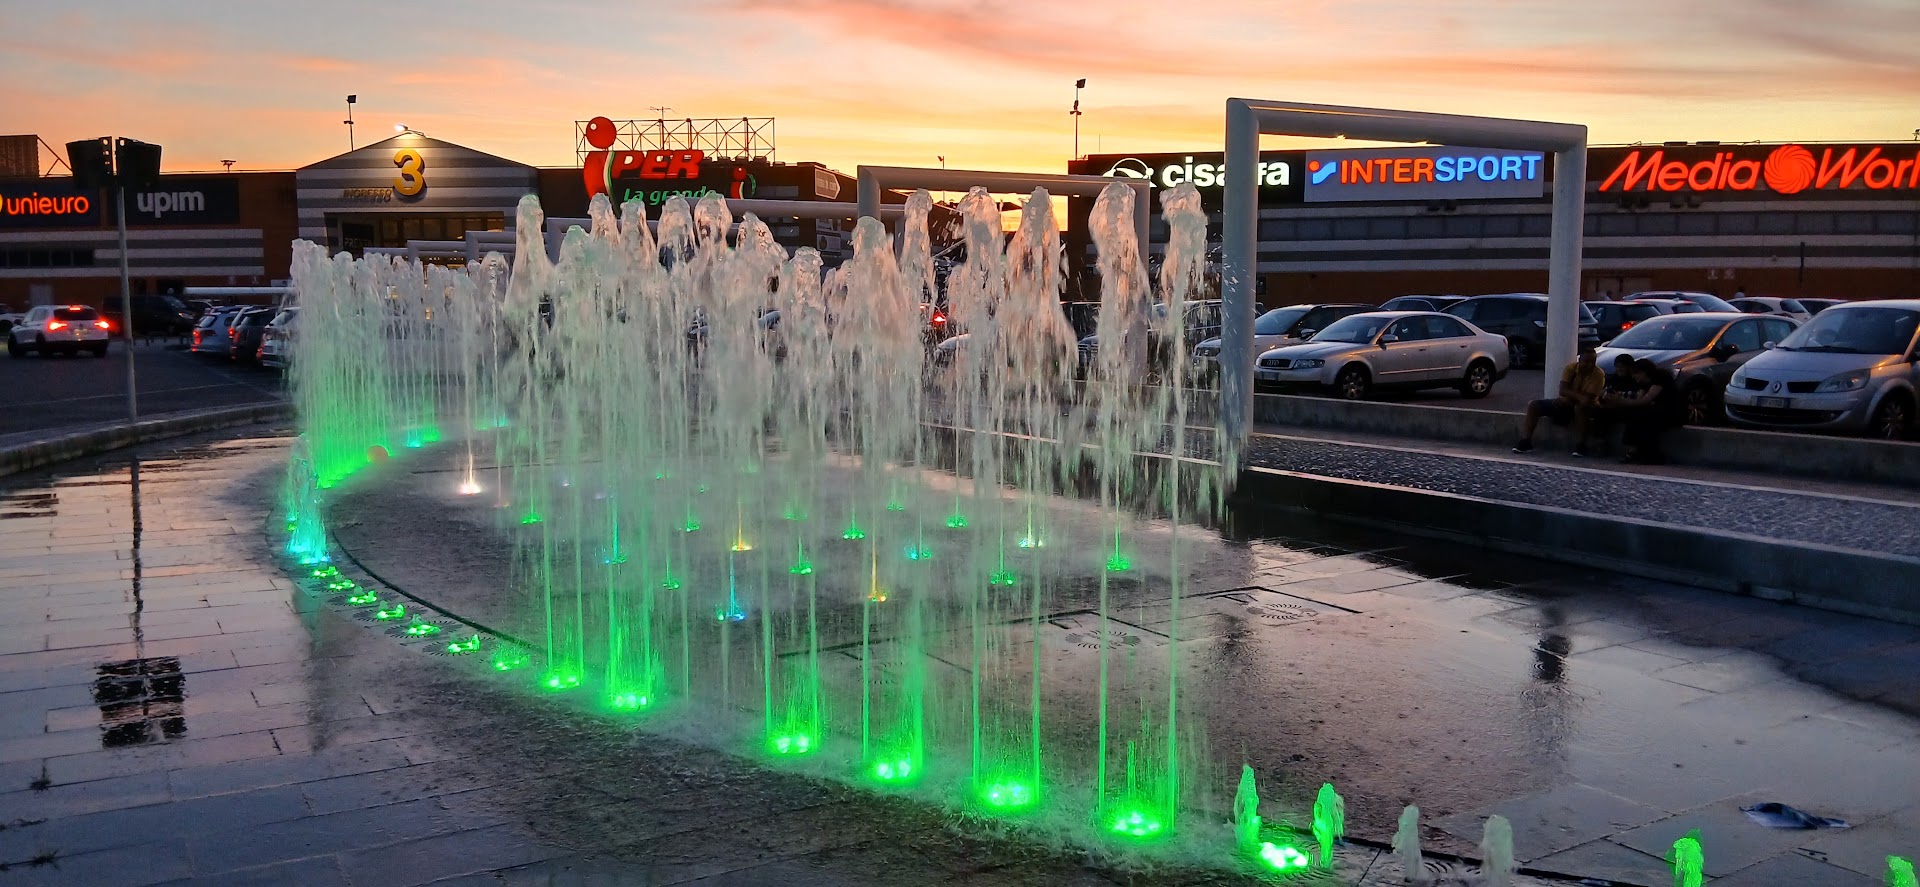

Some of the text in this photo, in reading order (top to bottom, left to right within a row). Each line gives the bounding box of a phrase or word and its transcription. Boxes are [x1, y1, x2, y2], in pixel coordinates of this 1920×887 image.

[393, 149, 425, 197] 3
[1340, 155, 1542, 185] INTERSPORT
[1599, 150, 1762, 192] Media
[7, 192, 89, 215] unieuro
[136, 190, 205, 218] upim
[623, 188, 645, 203] La
